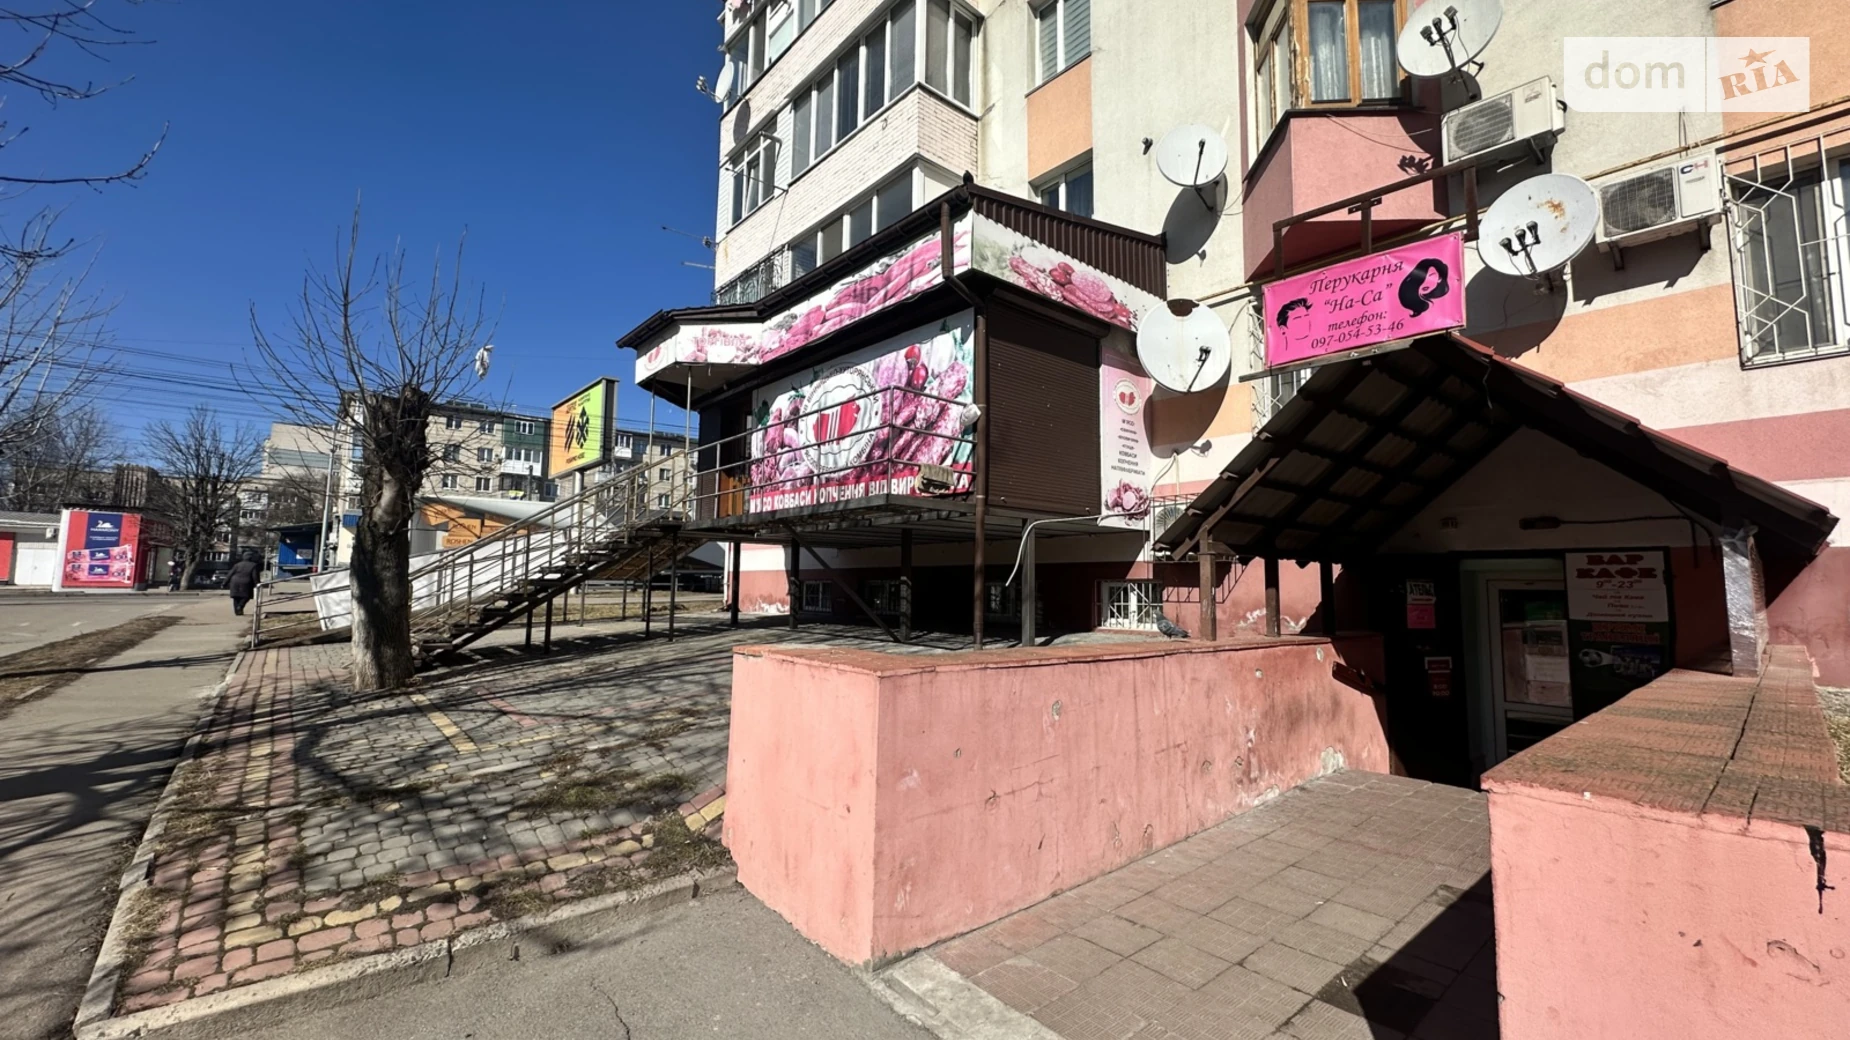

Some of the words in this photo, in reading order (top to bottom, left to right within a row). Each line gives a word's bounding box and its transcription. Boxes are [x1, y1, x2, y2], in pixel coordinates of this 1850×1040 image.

[1309, 261, 1404, 295] Перукарня
[1327, 310, 1388, 332] телефон:
[1311, 319, 1404, 349] 097-054-53-46
[774, 489, 812, 510] КОВБАСИ
[1586, 554, 1644, 565] БАР
[1575, 567, 1658, 579] КАФЕ
